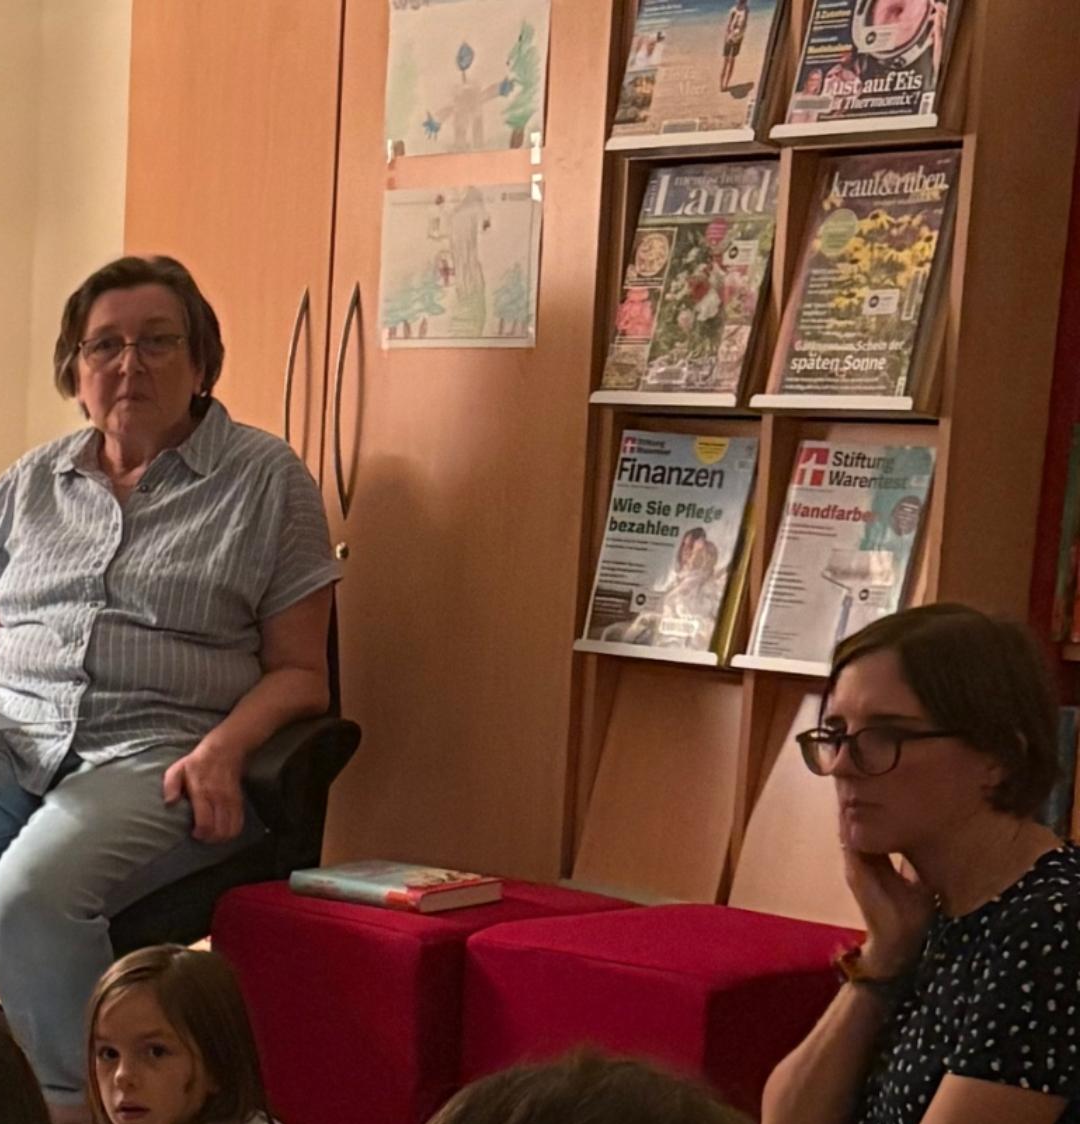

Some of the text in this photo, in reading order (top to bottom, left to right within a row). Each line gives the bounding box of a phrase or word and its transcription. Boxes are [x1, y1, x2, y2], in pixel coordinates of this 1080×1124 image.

[863, 73, 895, 93] auf
[894, 70, 923, 91] Eis
[652, 169, 772, 217] Land
[791, 353, 887, 374] späten Sonne
[618, 457, 726, 489] Finanzen
[831, 450, 895, 474] Stiftung
[828, 470, 908, 489] Warentest
[613, 497, 724, 523] Wie Sie Pflege
[608, 516, 680, 537] bezahlen
